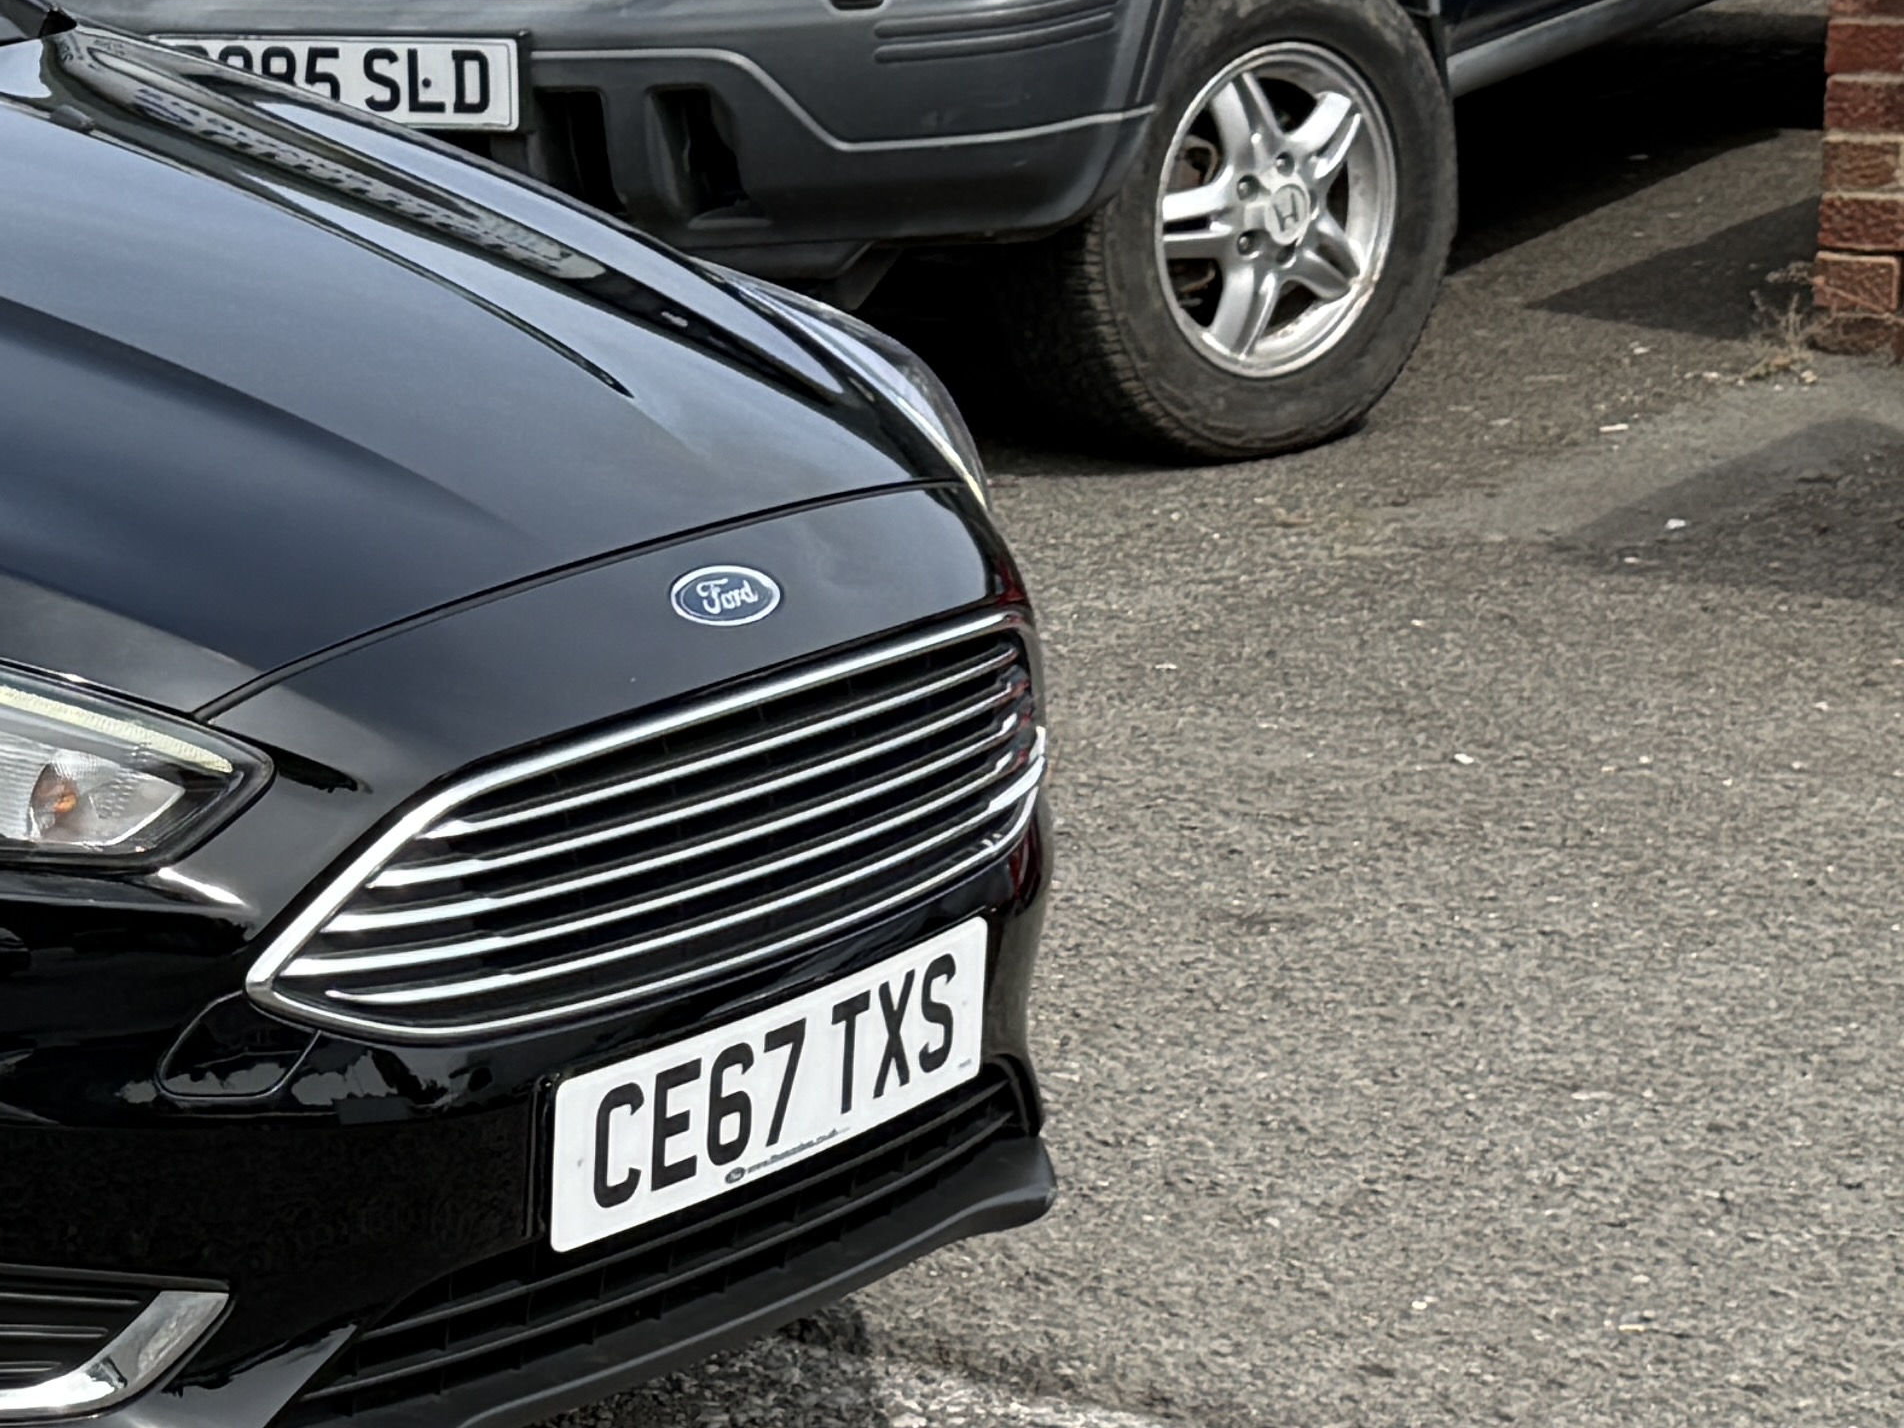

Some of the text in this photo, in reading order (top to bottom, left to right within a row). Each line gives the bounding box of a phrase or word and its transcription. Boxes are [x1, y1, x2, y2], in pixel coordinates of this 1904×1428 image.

[362, 46, 491, 114] SLD
[695, 578, 759, 614] Ford
[590, 952, 957, 1210] CE67 TXS
